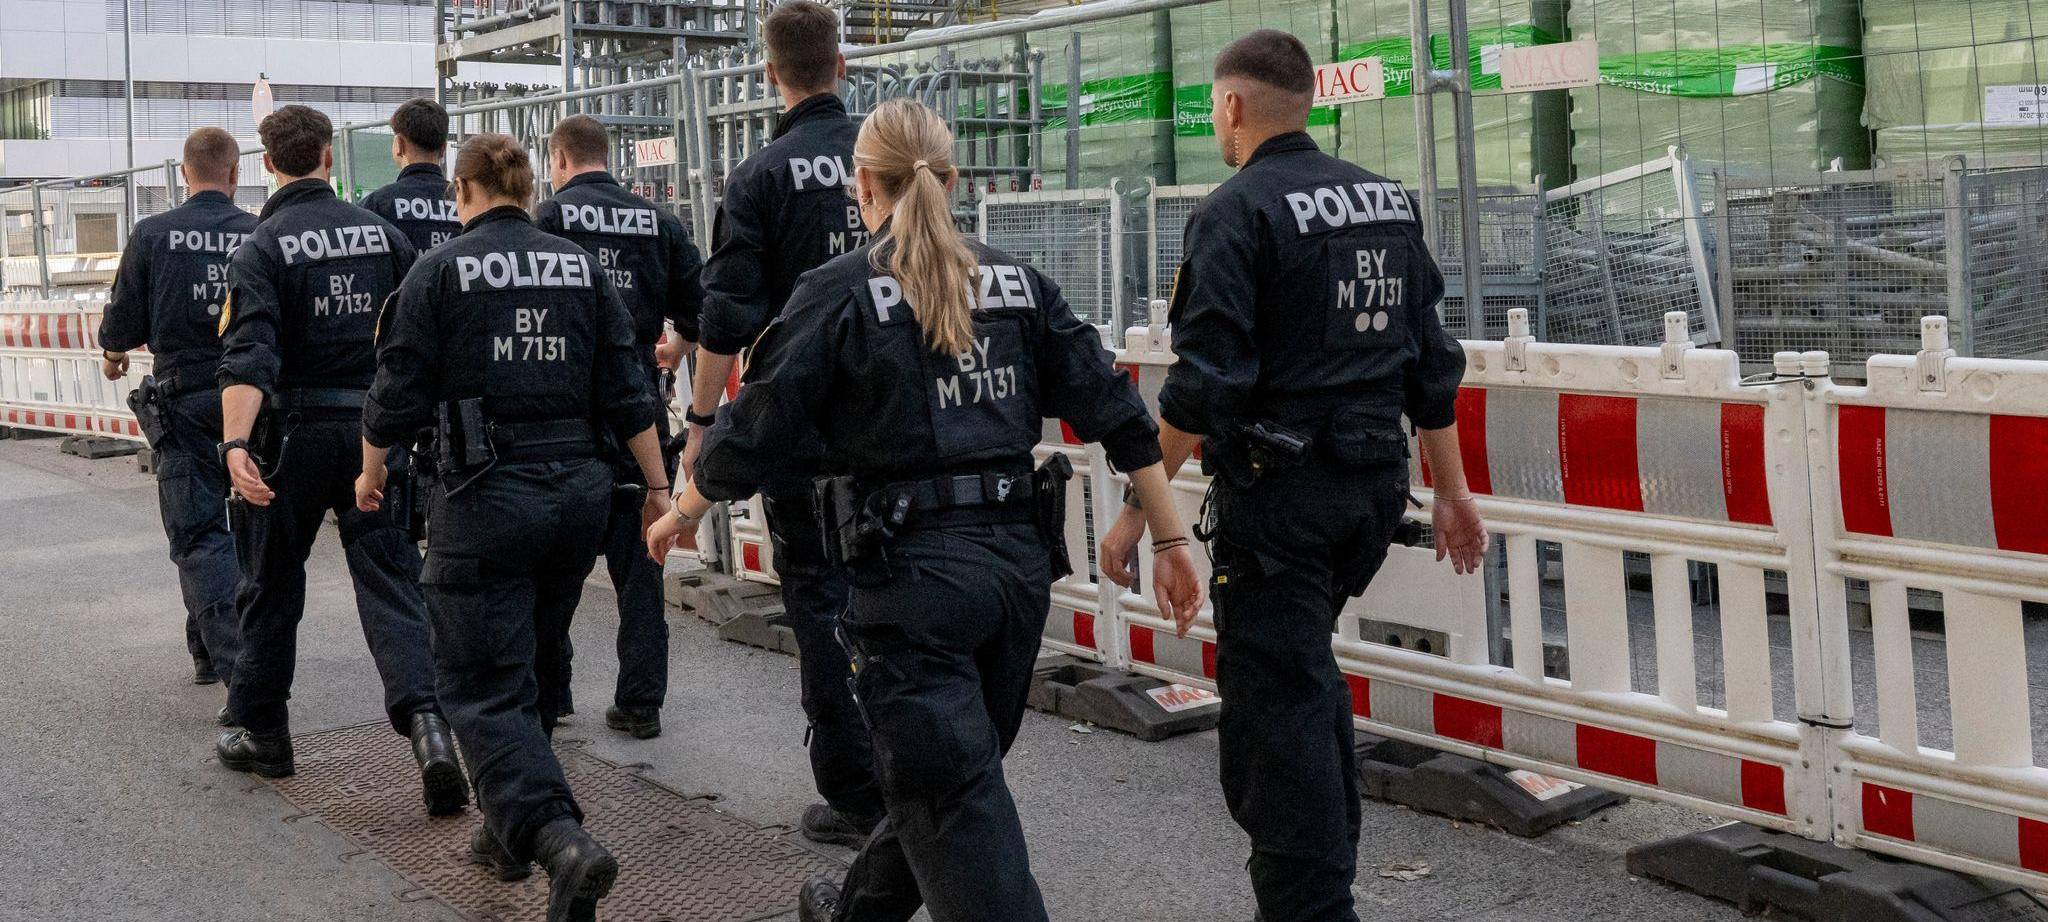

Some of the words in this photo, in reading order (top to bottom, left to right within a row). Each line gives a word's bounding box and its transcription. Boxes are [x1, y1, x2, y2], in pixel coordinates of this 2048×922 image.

[1513, 46, 1585, 82] MAC
[637, 140, 668, 161] MAC
[394, 197, 460, 222] POLIZ
[561, 204, 659, 236] POLIZEI
[846, 206, 861, 229] B
[1285, 182, 1416, 234] POLIZEI
[169, 230, 251, 252] POLIZ
[278, 225, 390, 265] POLIZEI
[829, 231, 845, 255] M
[851, 231, 870, 251] 71
[599, 247, 621, 267] BY
[1356, 249, 1387, 279] BY
[207, 263, 230, 281] BY
[456, 251, 592, 292] POLIZEI
[193, 282, 207, 300] M
[212, 281, 230, 300] 71
[329, 273, 355, 296] BY
[868, 265, 1036, 323] PIZEI
[1337, 280, 1356, 309] M
[1363, 277, 1403, 308] 7131
[314, 296, 330, 316] M
[334, 293, 372, 315] 7132
[515, 308, 549, 334] BY
[493, 336, 513, 361] M
[521, 336, 566, 361] 7131
[957, 336, 991, 373] BY
[936, 375, 962, 409] M
[969, 365, 1016, 404] 7131
